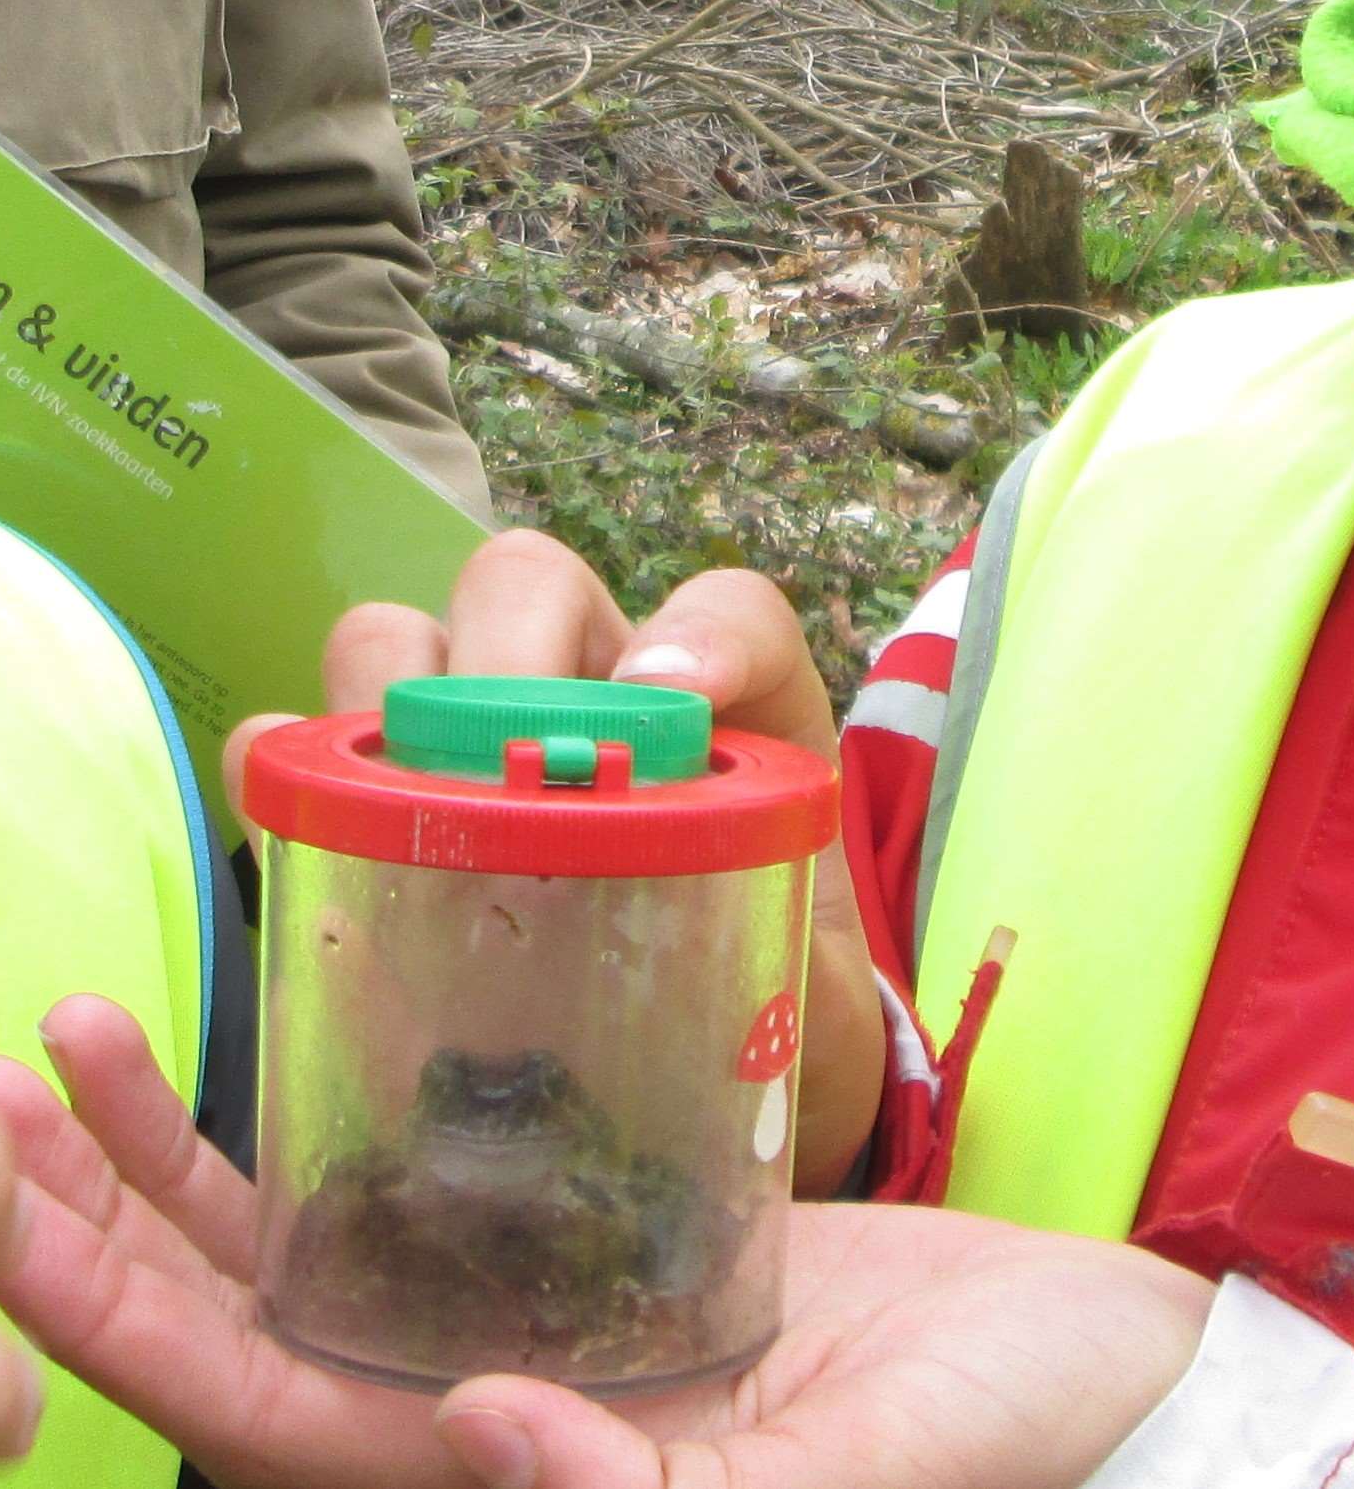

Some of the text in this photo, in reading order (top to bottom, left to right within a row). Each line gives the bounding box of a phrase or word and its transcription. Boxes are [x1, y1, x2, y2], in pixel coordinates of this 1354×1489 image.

[18, 304, 57, 355] &
[6, 364, 31, 390] de
[193, 688, 209, 705] Ga
[213, 682, 229, 699] op
